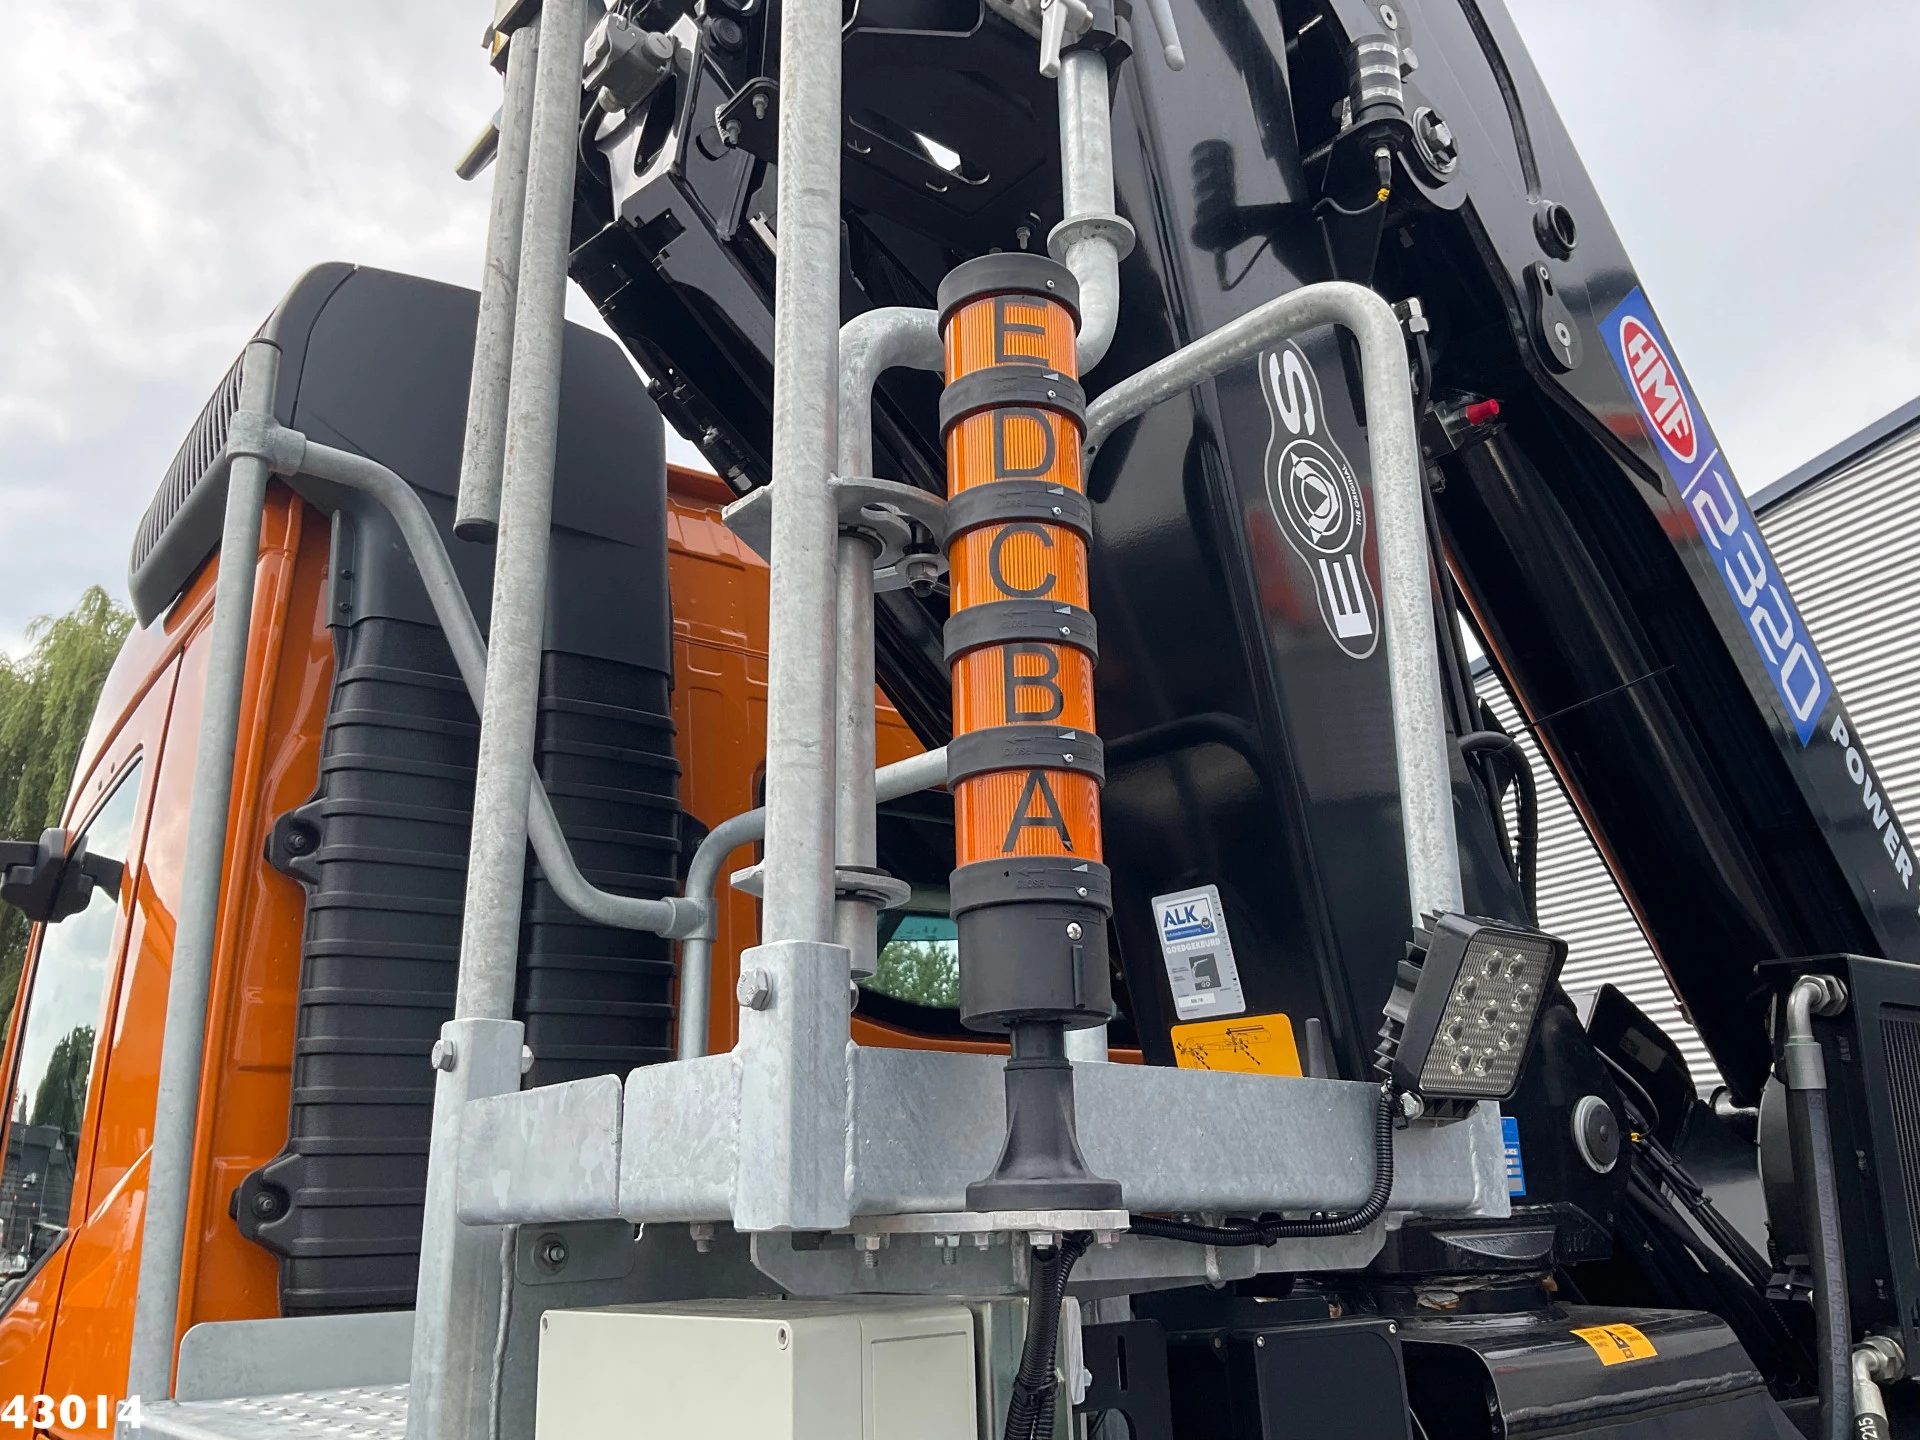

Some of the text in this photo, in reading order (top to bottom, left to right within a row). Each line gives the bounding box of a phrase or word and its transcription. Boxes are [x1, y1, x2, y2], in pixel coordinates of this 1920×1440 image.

[994, 297, 1049, 367] E
[1629, 332, 1691, 444] HMF
[994, 408, 1056, 479] D
[1342, 463, 1360, 508] ORIGINAL
[989, 523, 1057, 598] C
[1692, 470, 1823, 722] 2320
[1004, 643, 1064, 722] B
[1002, 770, 1075, 853] A
[1830, 714, 1914, 890] POWER
[1165, 906, 1198, 927] ALK
[1167, 938, 1220, 953] GOEDGEKEURD
